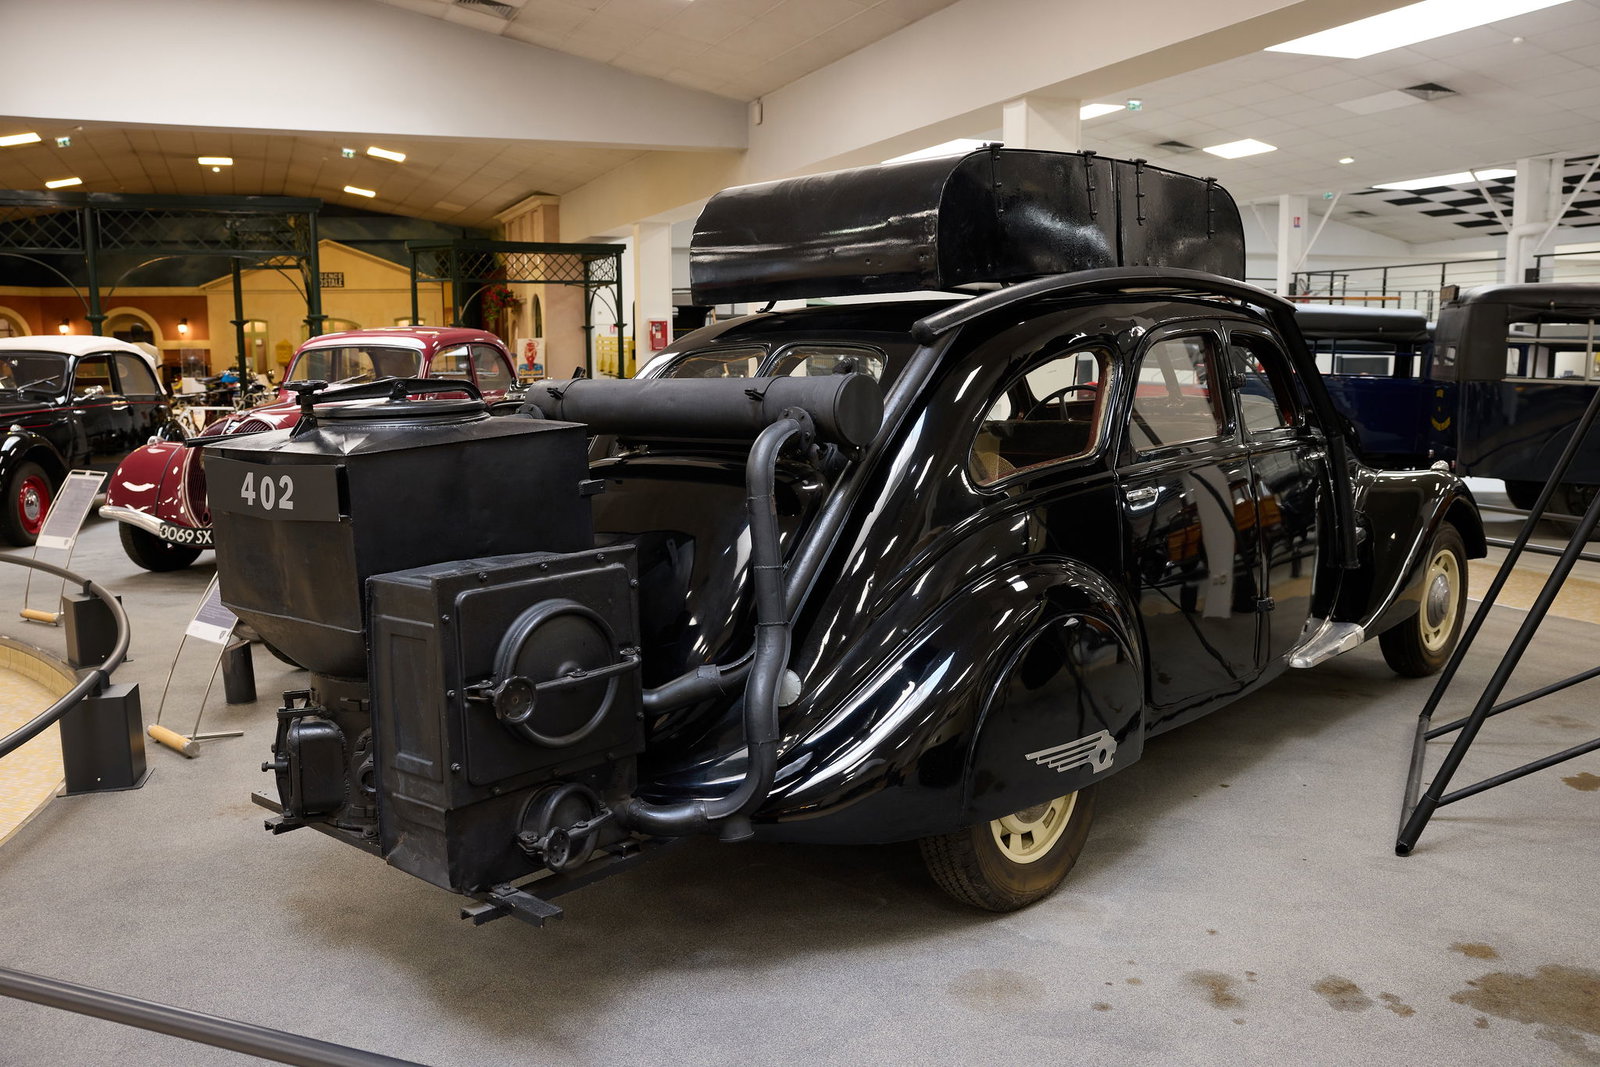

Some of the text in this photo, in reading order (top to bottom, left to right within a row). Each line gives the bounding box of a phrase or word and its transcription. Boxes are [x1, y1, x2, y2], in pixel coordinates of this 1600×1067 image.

[320, 279, 343, 287] OSTALE
[241, 472, 294, 510] 402
[160, 525, 212, 544] 3069 SX
